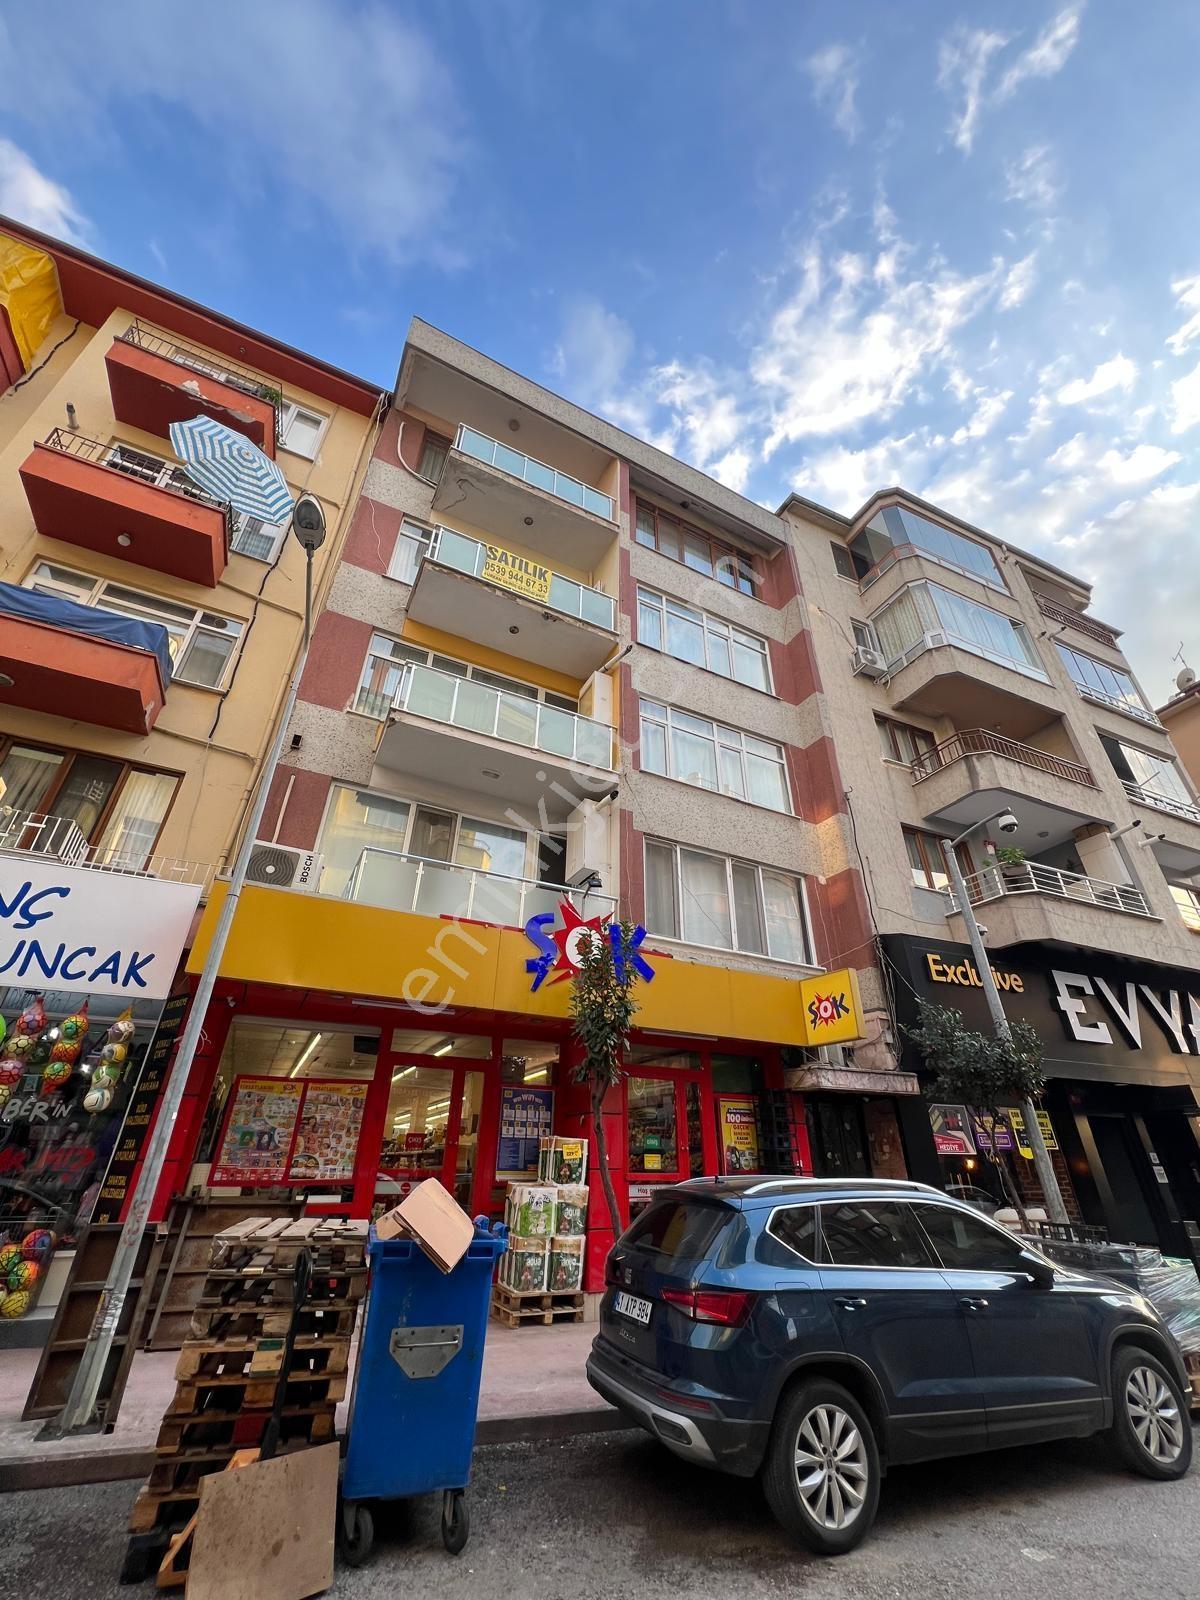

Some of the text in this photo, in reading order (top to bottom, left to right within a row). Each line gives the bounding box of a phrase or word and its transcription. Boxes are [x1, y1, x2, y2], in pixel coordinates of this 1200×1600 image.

[485, 561, 506, 576] 0539
[508, 570, 523, 584] 944
[538, 583, 548, 593] 33
[487, 546, 549, 582] SATILIK
[300, 855, 314, 883] BOSCH
[926, 953, 1025, 993] Excluive
[808, 992, 850, 1030] ŞOK
[726, 1113, 741, 1123] 100
